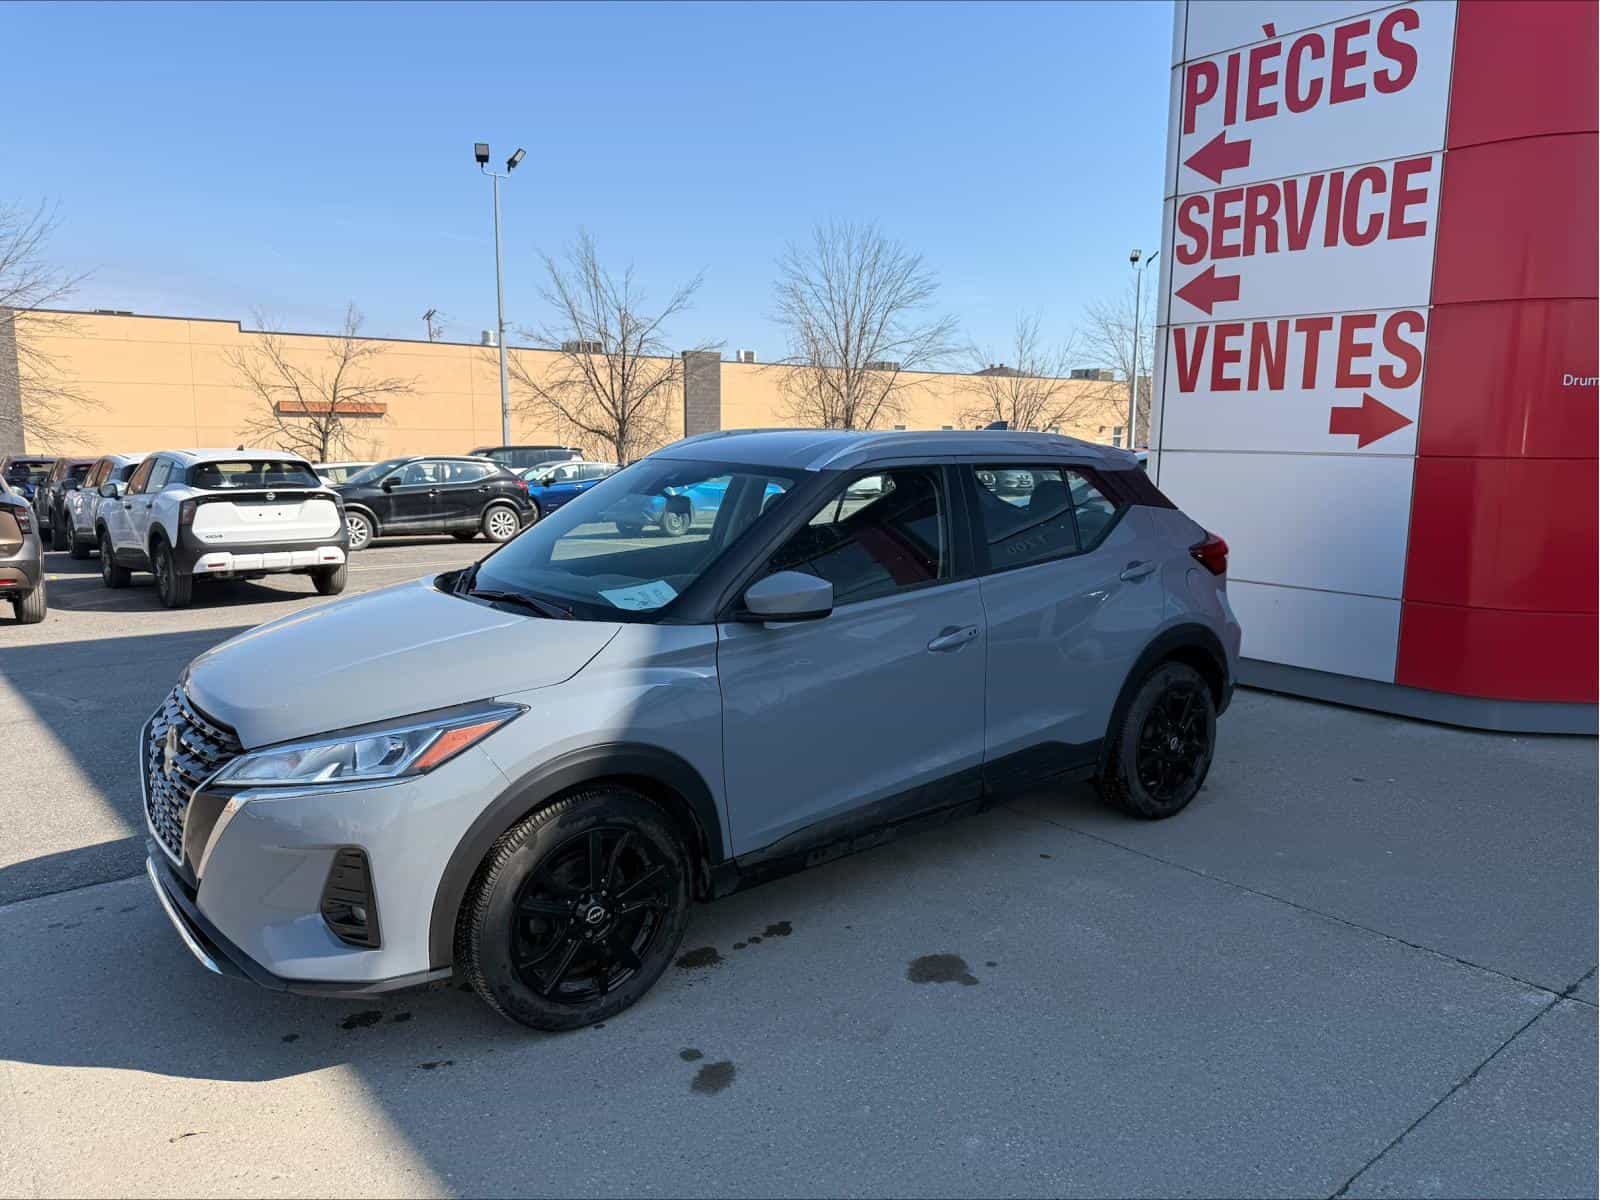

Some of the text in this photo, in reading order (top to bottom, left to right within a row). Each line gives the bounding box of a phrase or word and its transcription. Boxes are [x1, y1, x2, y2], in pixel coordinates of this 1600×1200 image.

[1184, 8, 1420, 135] PIÈCES
[1176, 156, 1433, 266] SERVICE
[1173, 311, 1426, 393] VENTES
